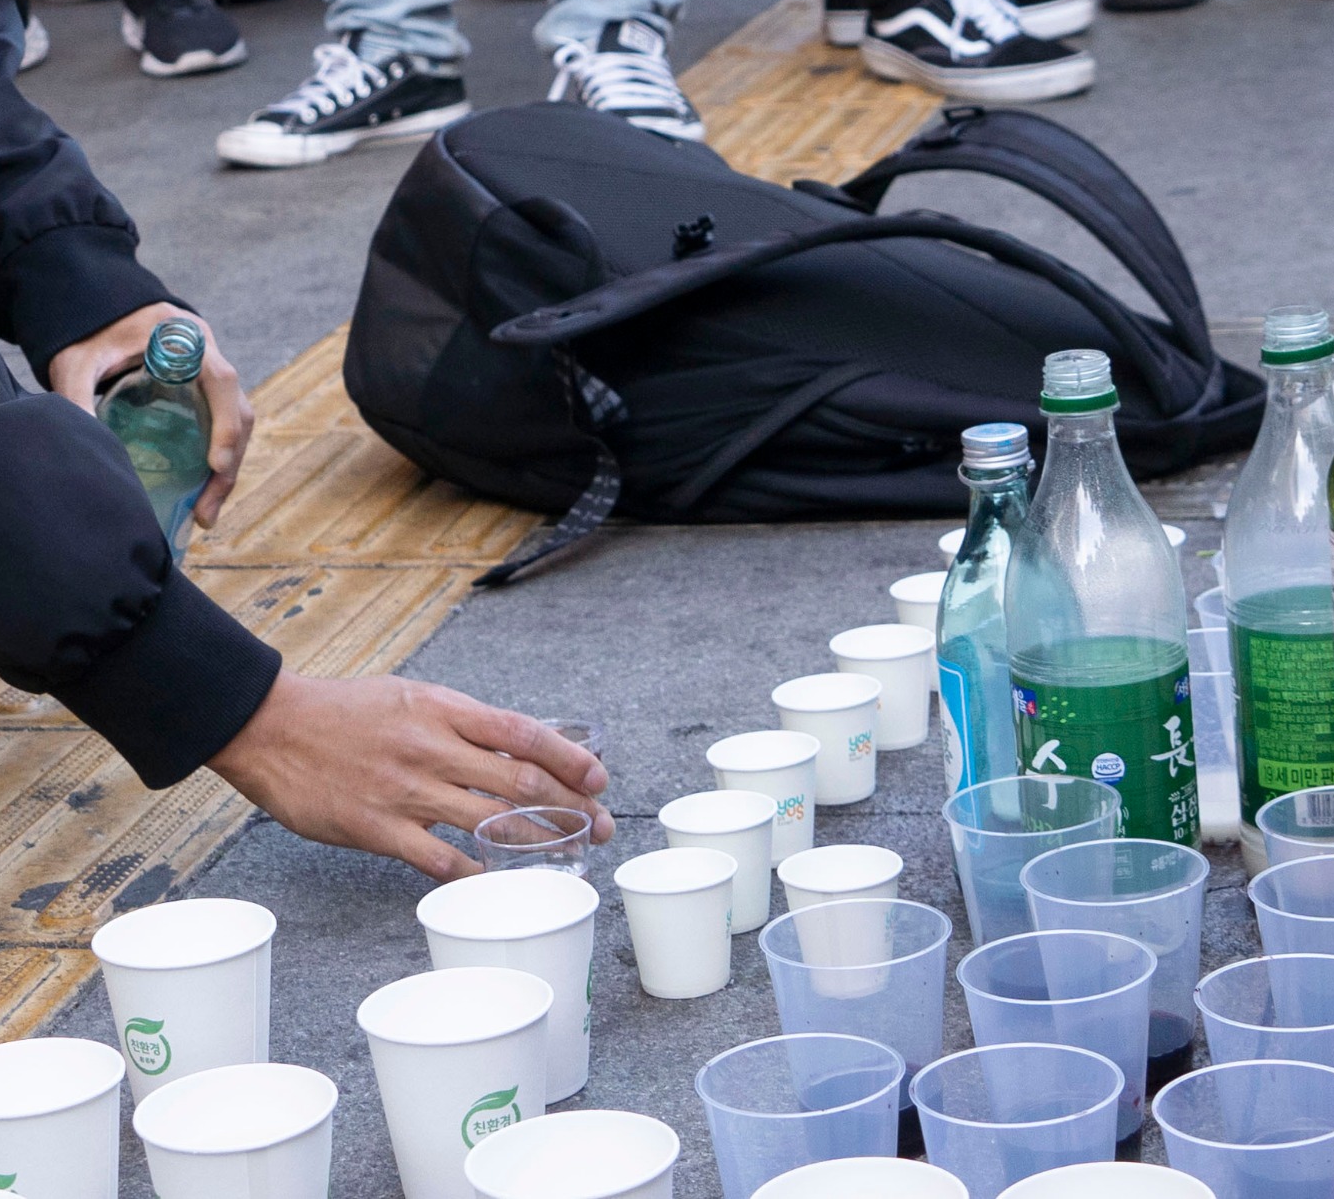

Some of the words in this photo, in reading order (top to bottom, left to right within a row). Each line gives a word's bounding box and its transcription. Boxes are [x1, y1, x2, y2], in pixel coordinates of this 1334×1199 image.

[1096, 762, 1121, 772] HACCP
[1291, 767, 1319, 787] 미만
[130, 1038, 161, 1057] 친환경
[472, 1113, 511, 1135] 친환경
